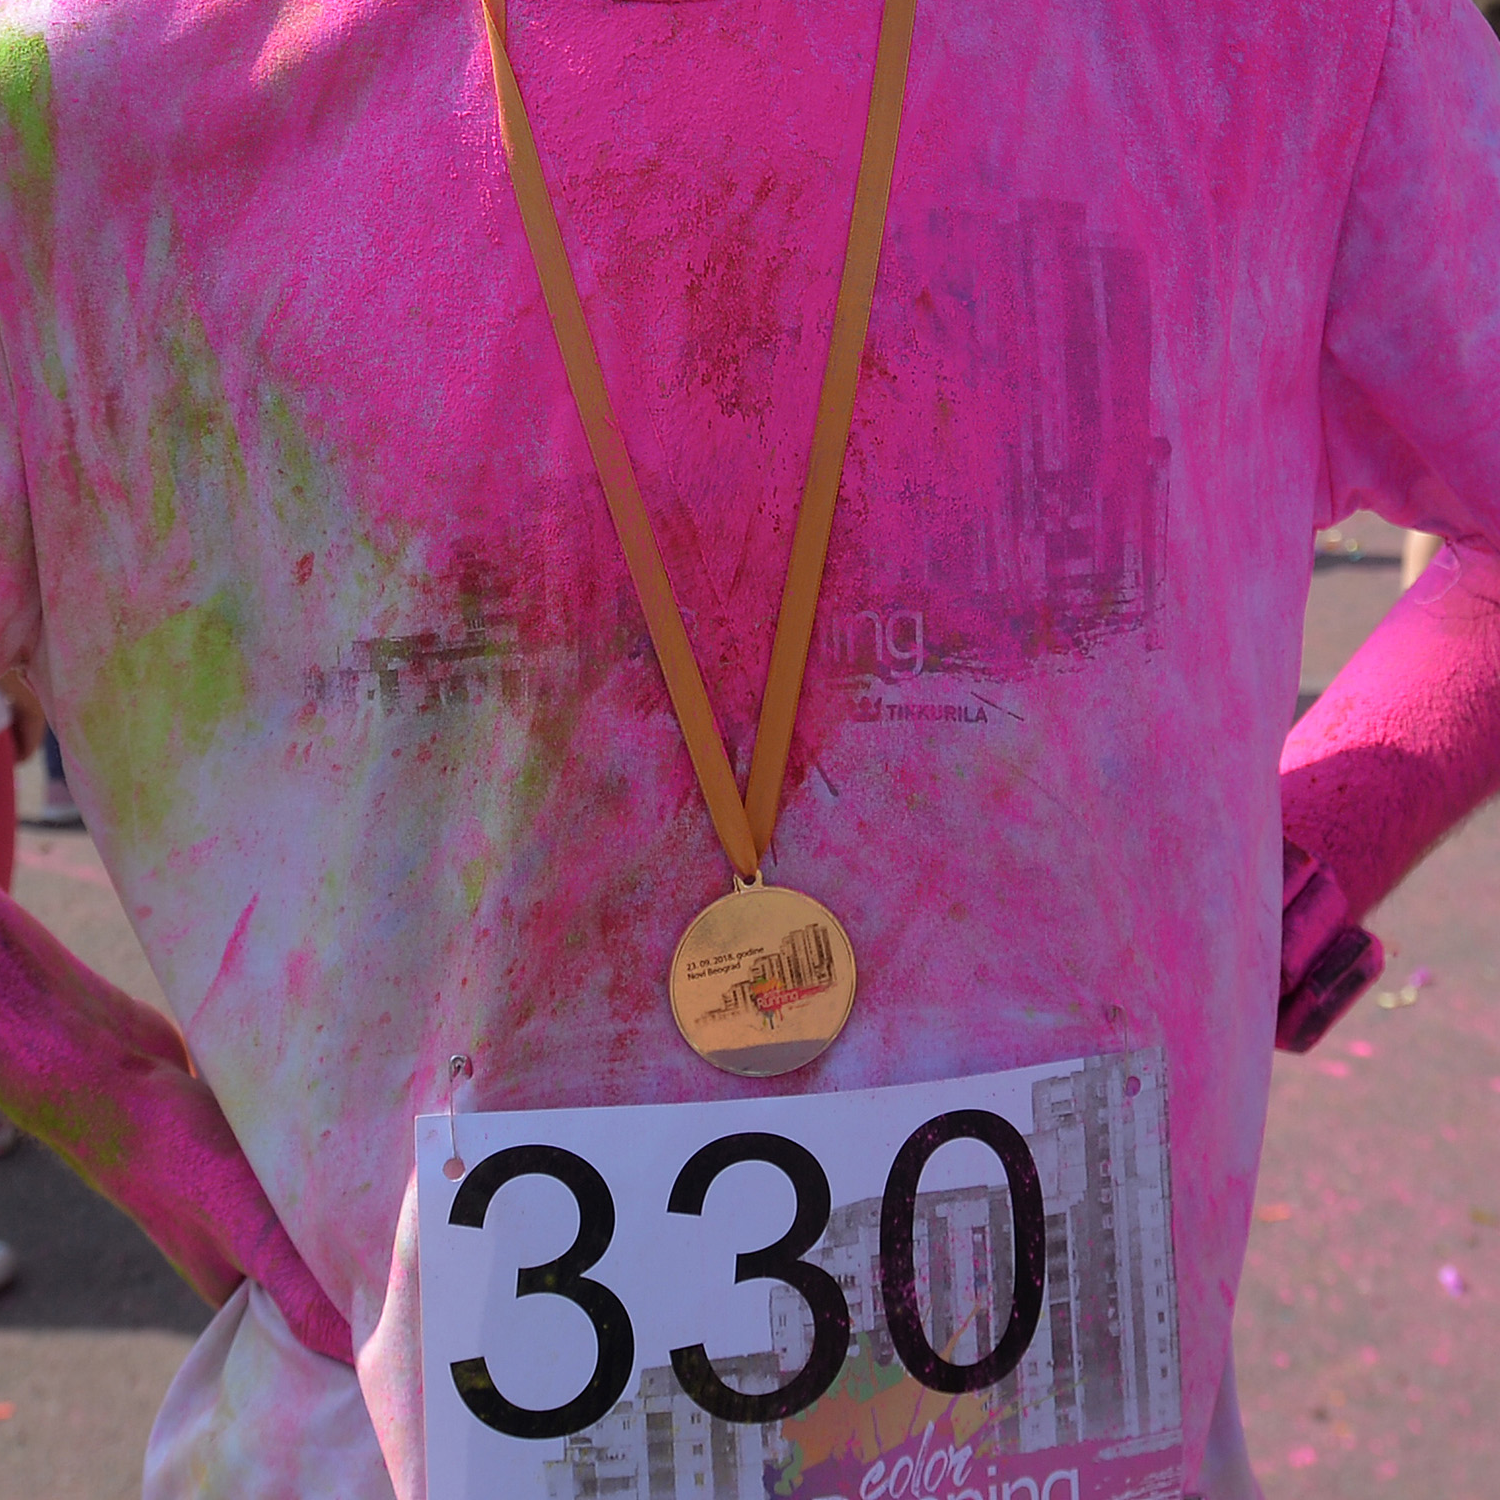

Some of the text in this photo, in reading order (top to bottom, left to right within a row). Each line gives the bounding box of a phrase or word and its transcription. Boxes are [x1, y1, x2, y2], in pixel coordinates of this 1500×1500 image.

[687, 961, 741, 980] Novi Beograd
[736, 947, 764, 960] godine
[448, 1108, 1047, 1440] 330
[859, 1419, 974, 1500] color
